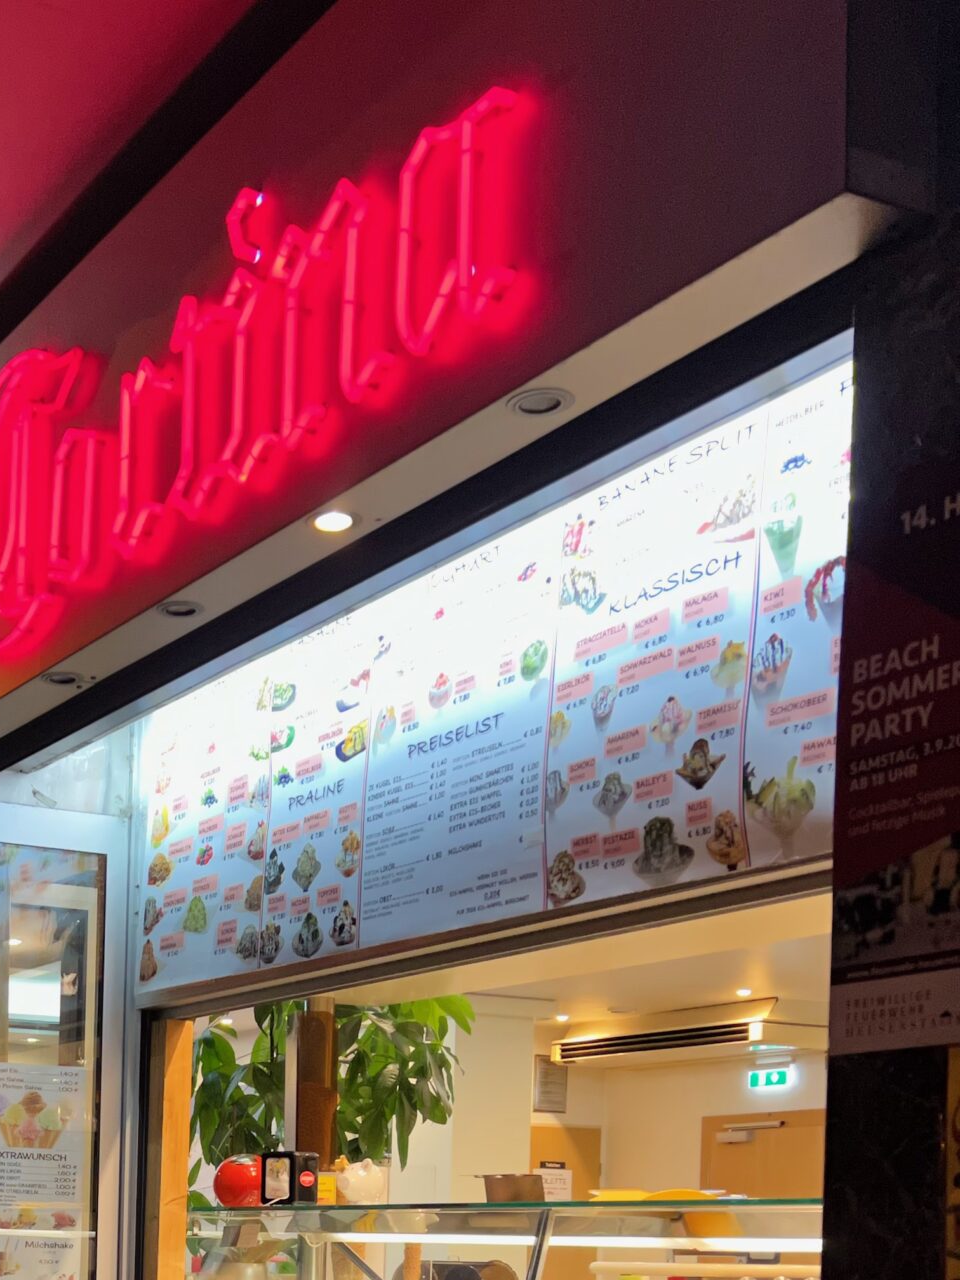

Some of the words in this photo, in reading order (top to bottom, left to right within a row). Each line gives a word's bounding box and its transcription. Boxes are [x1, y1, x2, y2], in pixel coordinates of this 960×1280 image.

[686, 423, 757, 465] SPLIT
[609, 551, 742, 616] KLASSISCH
[764, 587, 784, 601] KIWI
[685, 592, 719, 608] MALAGA
[635, 615, 659, 629] MOKKA
[576, 622, 627, 648] STRACCIATELLA
[679, 638, 717, 656] WALNUSS
[620, 648, 673, 674] SCHWARZWALD
[853, 634, 940, 684] BEACH
[770, 693, 827, 716] SCHOKOBEER
[407, 712, 505, 759] PREISELIST
[851, 701, 934, 748] PARTY
[570, 758, 596, 773] SCHOKO
[888, 763, 918, 783] UHR
[288, 778, 346, 812] PRALINE
[24, 1240, 74, 1249] Milchshake
